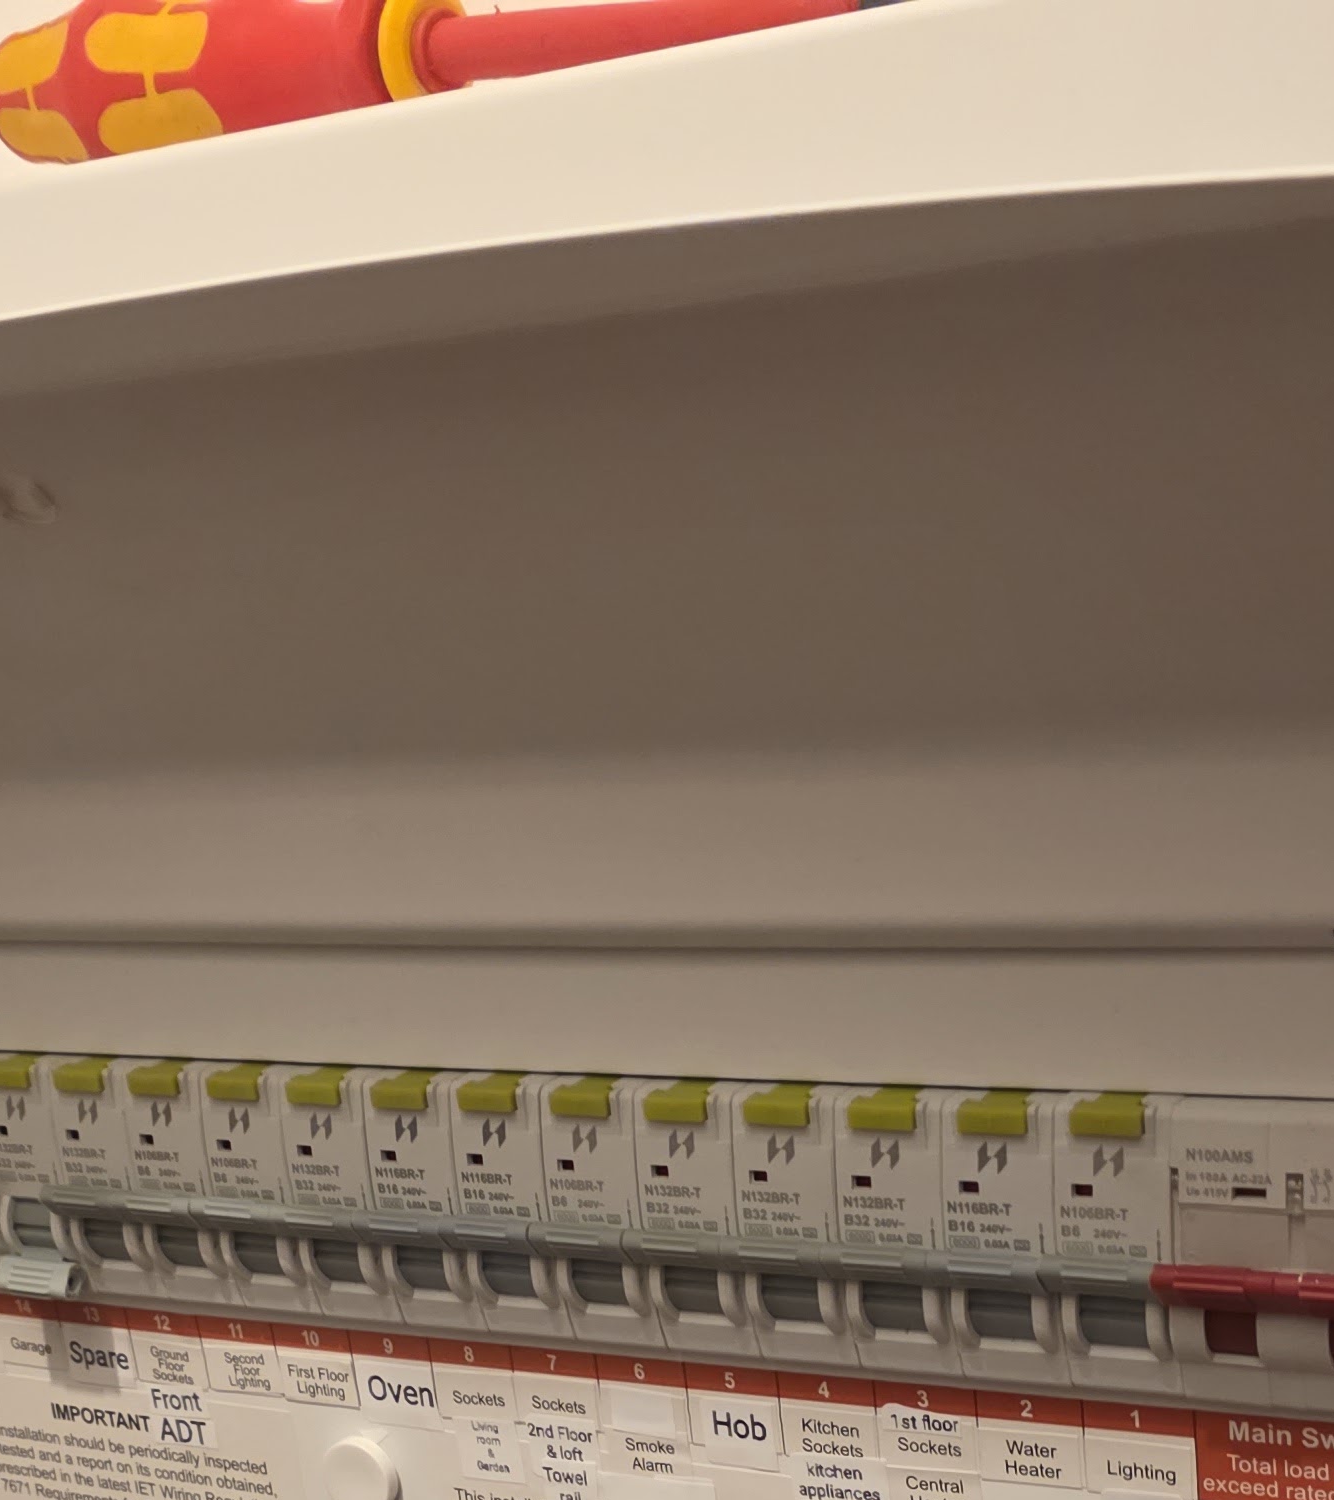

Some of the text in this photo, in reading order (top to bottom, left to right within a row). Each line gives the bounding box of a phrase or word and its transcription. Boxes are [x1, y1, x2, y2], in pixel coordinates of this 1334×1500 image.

[1186, 1149, 1254, 1164] N100AMS
[377, 1183, 399, 1195] B16
[464, 1187, 486, 1200] B16
[844, 1213, 870, 1227] B32
[948, 1219, 975, 1232] B16
[14, 1298, 32, 1315] 14
[83, 1305, 100, 1322] 13
[153, 1314, 171, 1331] 12
[228, 1322, 244, 1339] 11
[10, 1337, 53, 1355] Garage
[302, 1330, 320, 1347] 10
[382, 1338, 394, 1355] 9
[69, 1341, 130, 1369] Spare
[150, 1346, 190, 1362] Ground
[224, 1352, 265, 1367] Second
[463, 1346, 474, 1363] 8
[547, 1354, 557, 1371] 7
[158, 1359, 185, 1373] Floor
[233, 1363, 261, 1377] Floor
[287, 1364, 349, 1384] First Floor
[634, 1363, 645, 1380] 6
[153, 1369, 195, 1385] Sockets
[228, 1374, 271, 1391] Lighting
[724, 1372, 736, 1390] 5
[297, 1381, 346, 1401] Lighting
[368, 1376, 434, 1407] Oven
[818, 1381, 830, 1398] 4
[916, 1389, 929, 1408] 3
[151, 1389, 202, 1412] Front
[453, 1390, 505, 1408] Sockets
[532, 1396, 586, 1415] Sockets
[1020, 1399, 1033, 1417] 2
[51, 1402, 150, 1432] IMPORTANT
[712, 1411, 767, 1441] Hob
[890, 1414, 959, 1432] 1st floor
[1130, 1410, 1140, 1428] 1
[161, 1418, 206, 1445] ADT
[471, 1421, 499, 1435] Living
[528, 1423, 593, 1444] 2nd Floor
[801, 1418, 860, 1438] Kitchen
[1228, 1420, 1293, 1446] Main
[476, 1435, 501, 1447] room
[625, 1438, 675, 1455] Smoke
[802, 1439, 864, 1458] Sockets
[897, 1438, 962, 1458] Sockets
[1005, 1439, 1057, 1459] Water
[547, 1445, 583, 1462] & loft
[477, 1461, 511, 1474] Garden
[632, 1458, 673, 1474] Alarm
[806, 1462, 863, 1481] kitchen
[1005, 1460, 1062, 1479] Heater
[1107, 1461, 1177, 1486] Lighting
[1227, 1454, 1277, 1476] Total
[1285, 1460, 1329, 1481] load
[61, 1468, 71, 1482] in
[75, 1472, 94, 1487] the
[98, 1475, 131, 1493] latest
[135, 1481, 156, 1496] IET
[543, 1467, 588, 1486] Towel
[906, 1476, 964, 1494] Central
[1203, 1478, 1278, 1498] exceed
